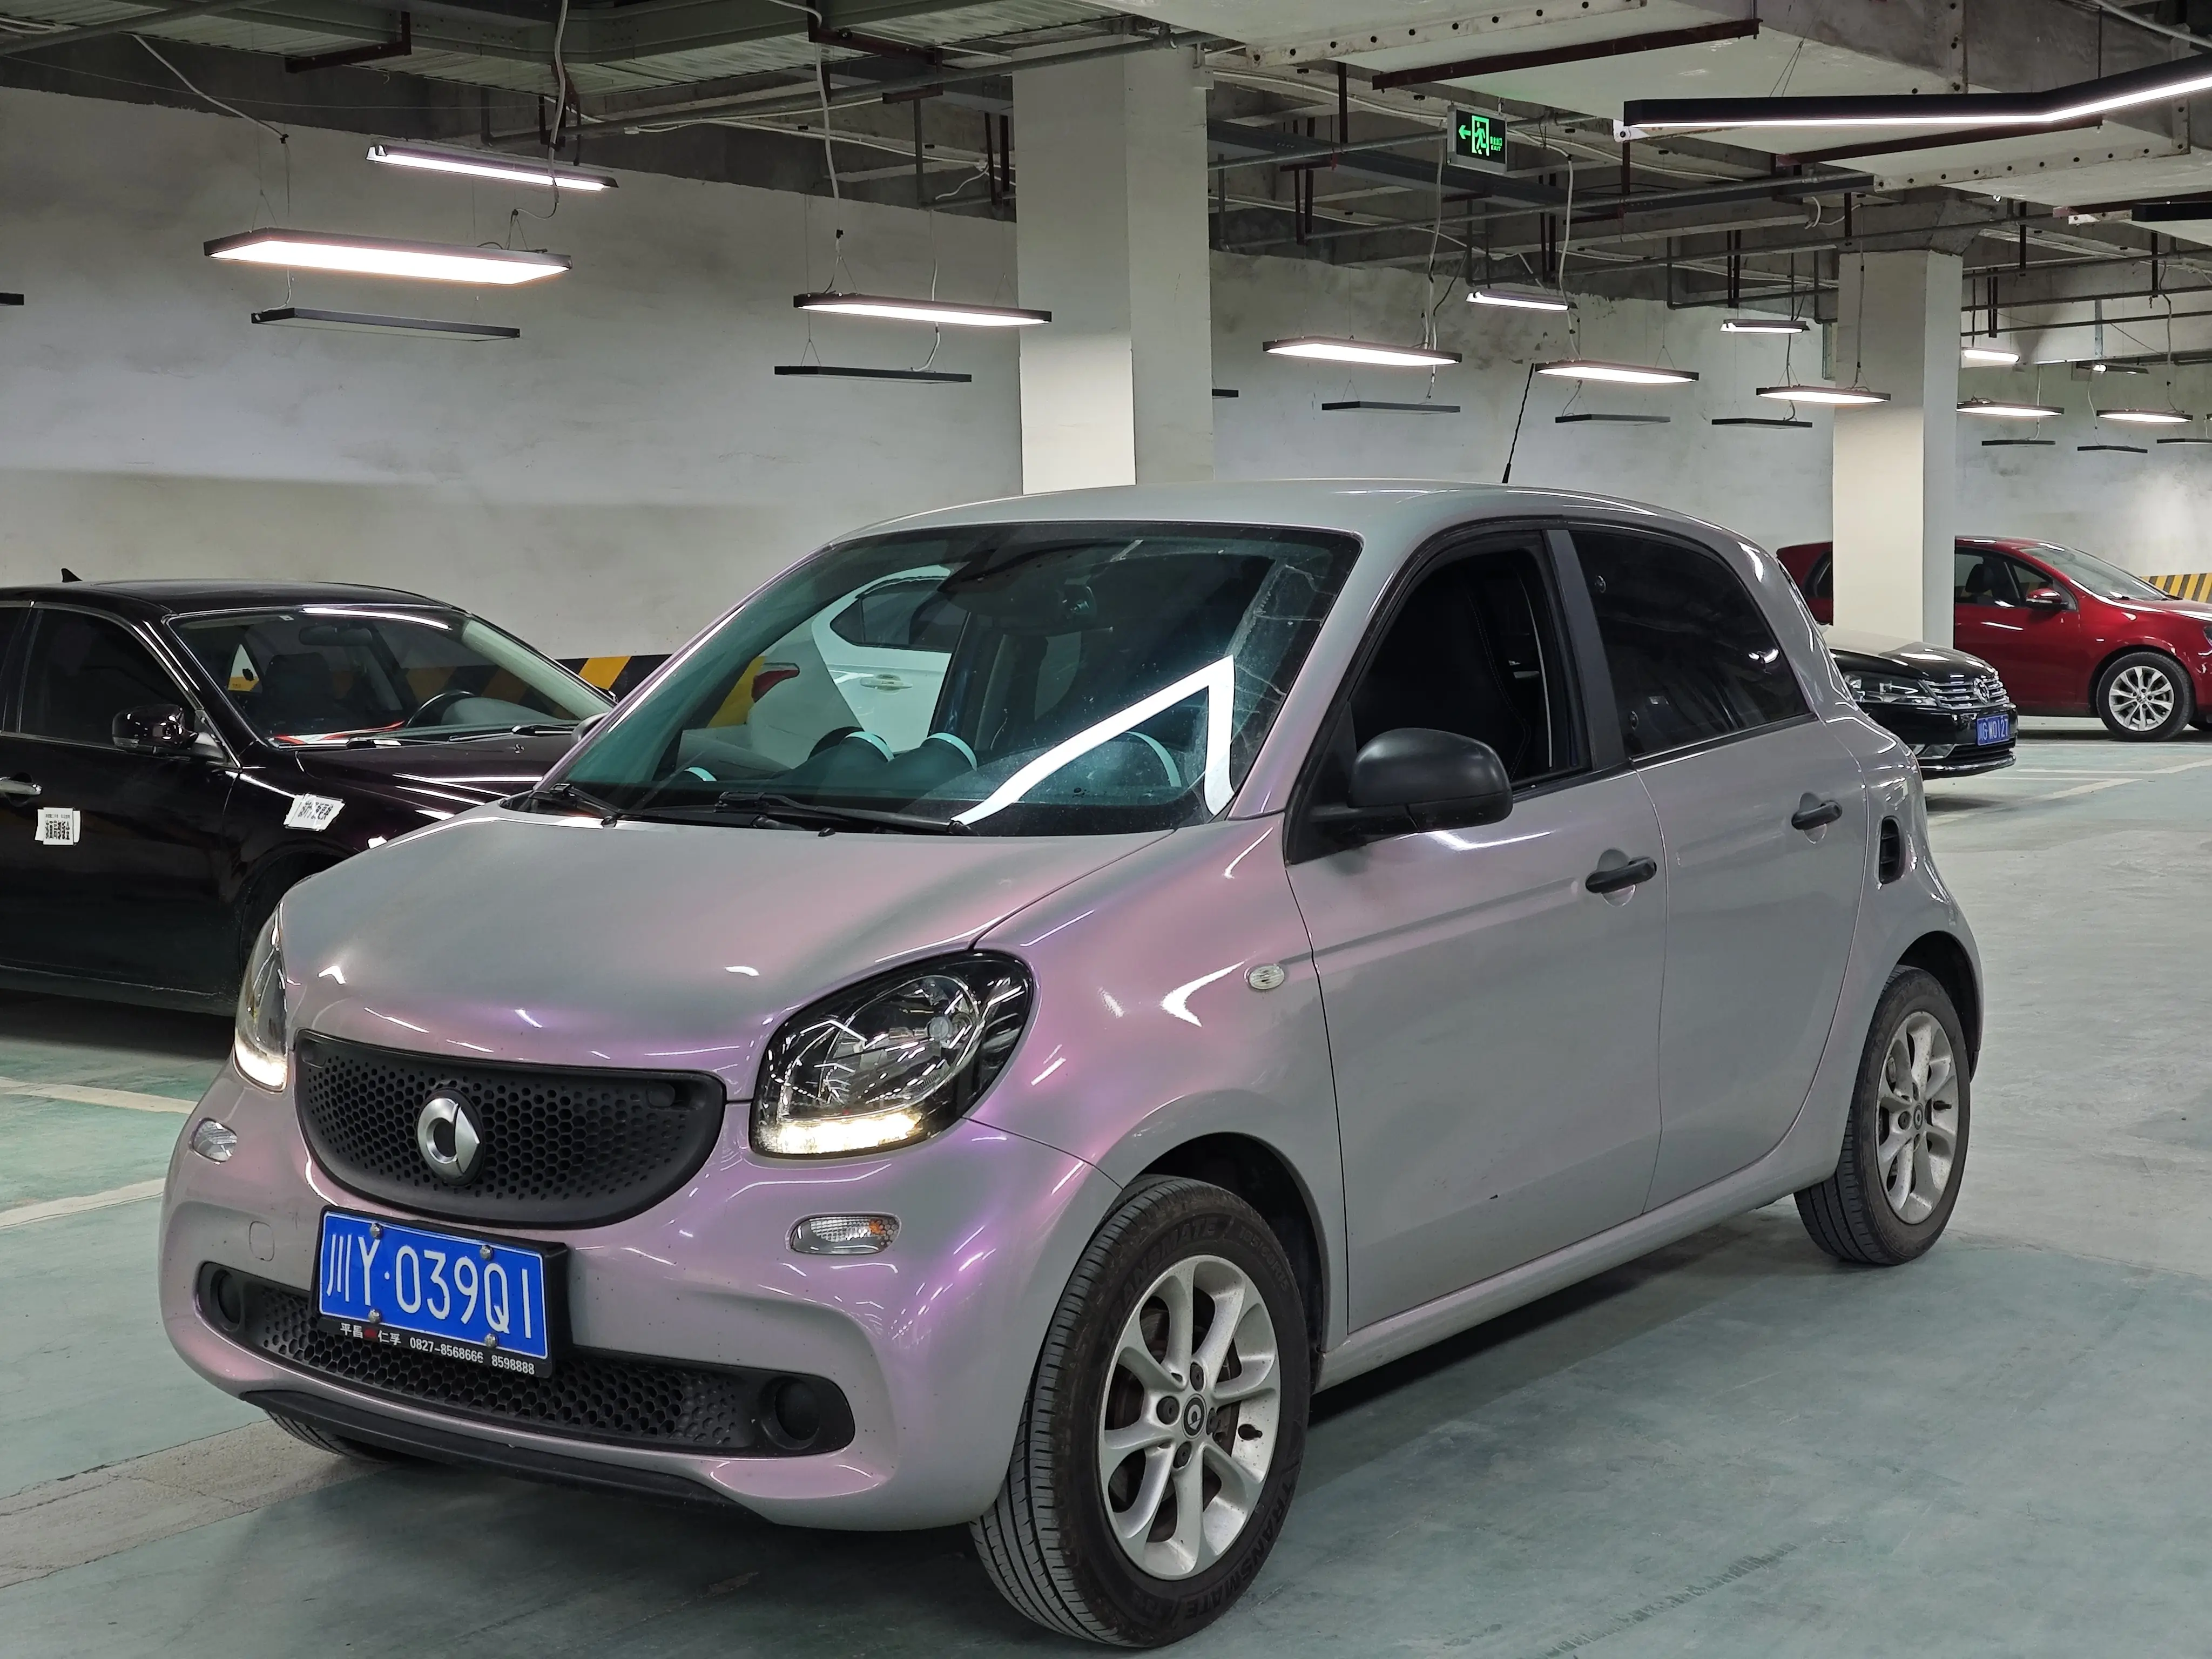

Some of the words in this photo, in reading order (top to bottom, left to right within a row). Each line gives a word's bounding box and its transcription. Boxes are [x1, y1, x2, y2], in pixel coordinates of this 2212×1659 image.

[340, 1323, 363, 1339] 平昌
[410, 1337, 484, 1364] 0827-8568666
[491, 1354, 535, 1375] 8598888
